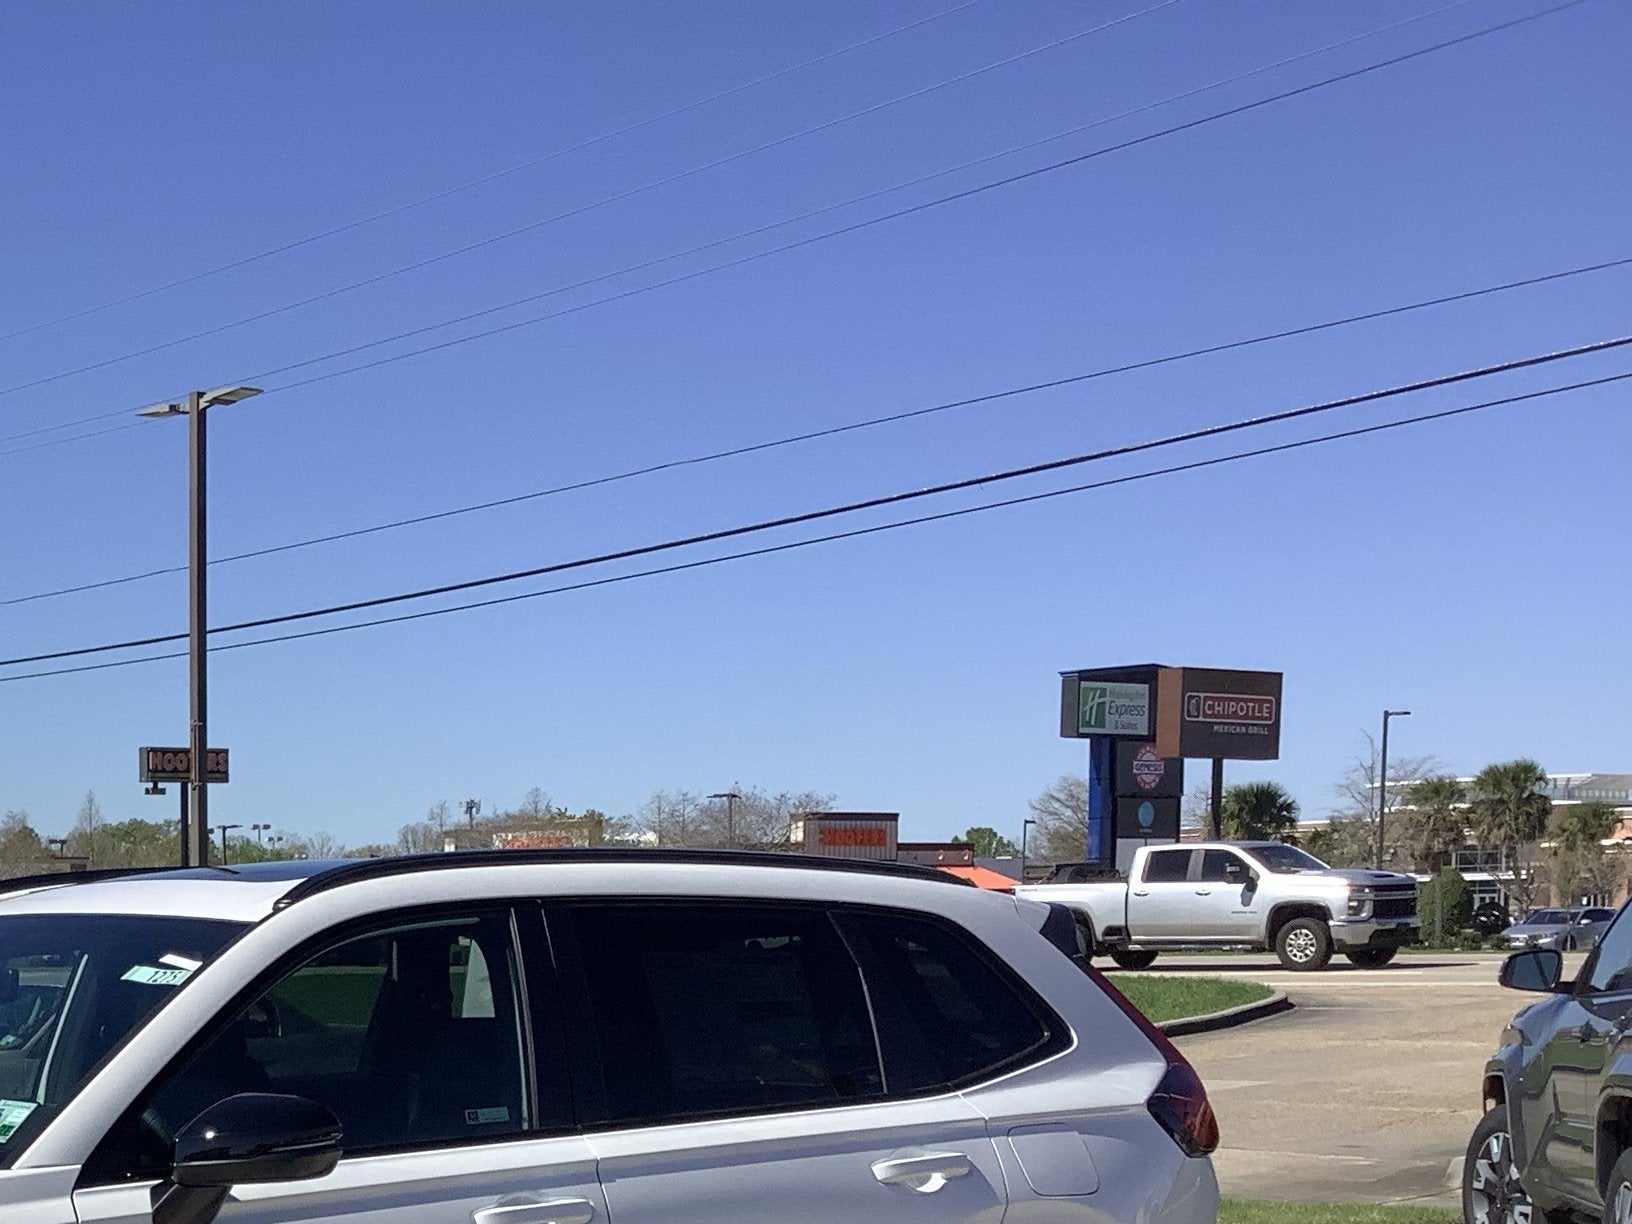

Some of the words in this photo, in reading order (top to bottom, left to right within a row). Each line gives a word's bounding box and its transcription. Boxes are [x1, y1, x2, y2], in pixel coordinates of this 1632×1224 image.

[1108, 700, 1146, 718] Express
[1204, 700, 1270, 717] CHIPOTLE
[149, 751, 227, 772] HOORS
